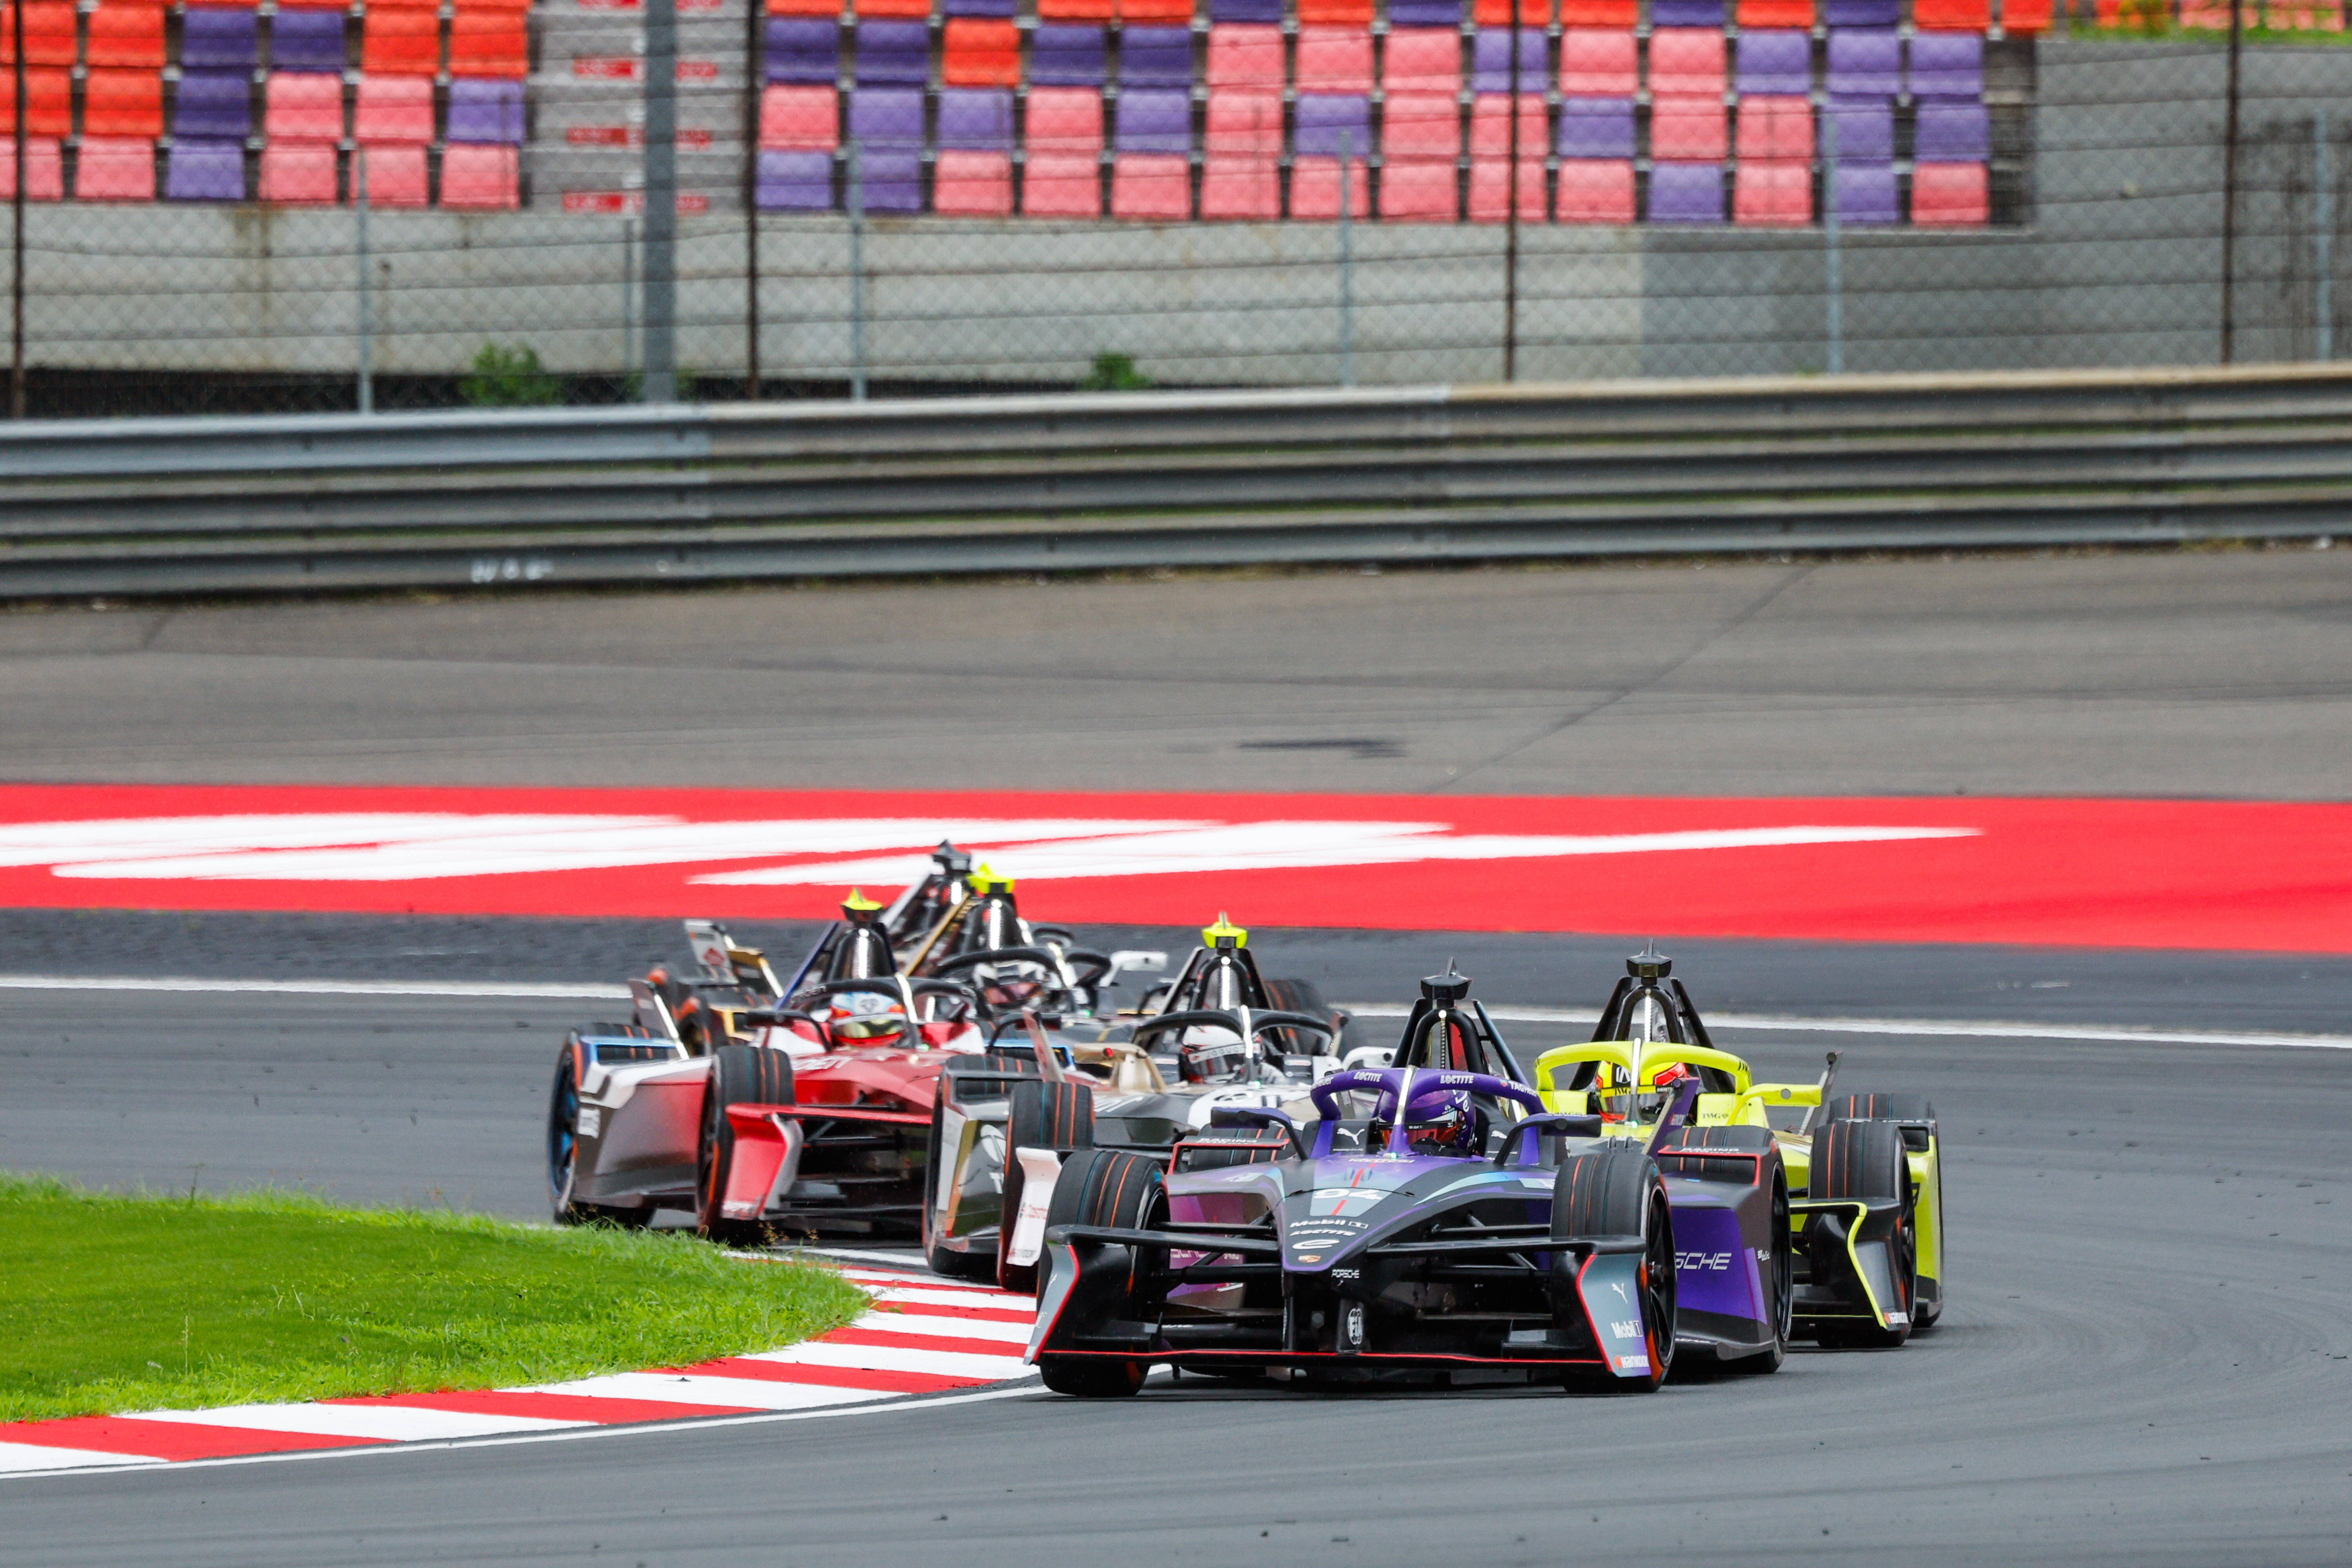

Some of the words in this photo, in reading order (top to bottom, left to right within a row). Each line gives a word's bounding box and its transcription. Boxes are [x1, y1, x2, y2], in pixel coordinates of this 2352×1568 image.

[1353, 1071, 1383, 1083] LOCTITE
[1440, 1075, 1474, 1084] LOCTITE
[1313, 1188, 1383, 1200] 94
[1289, 1219, 1346, 1228] Mobil
[1675, 1252, 1732, 1270] SCHE
[1331, 1269, 1360, 1279] PORSCHE
[1611, 1321, 1637, 1339] Mobil
